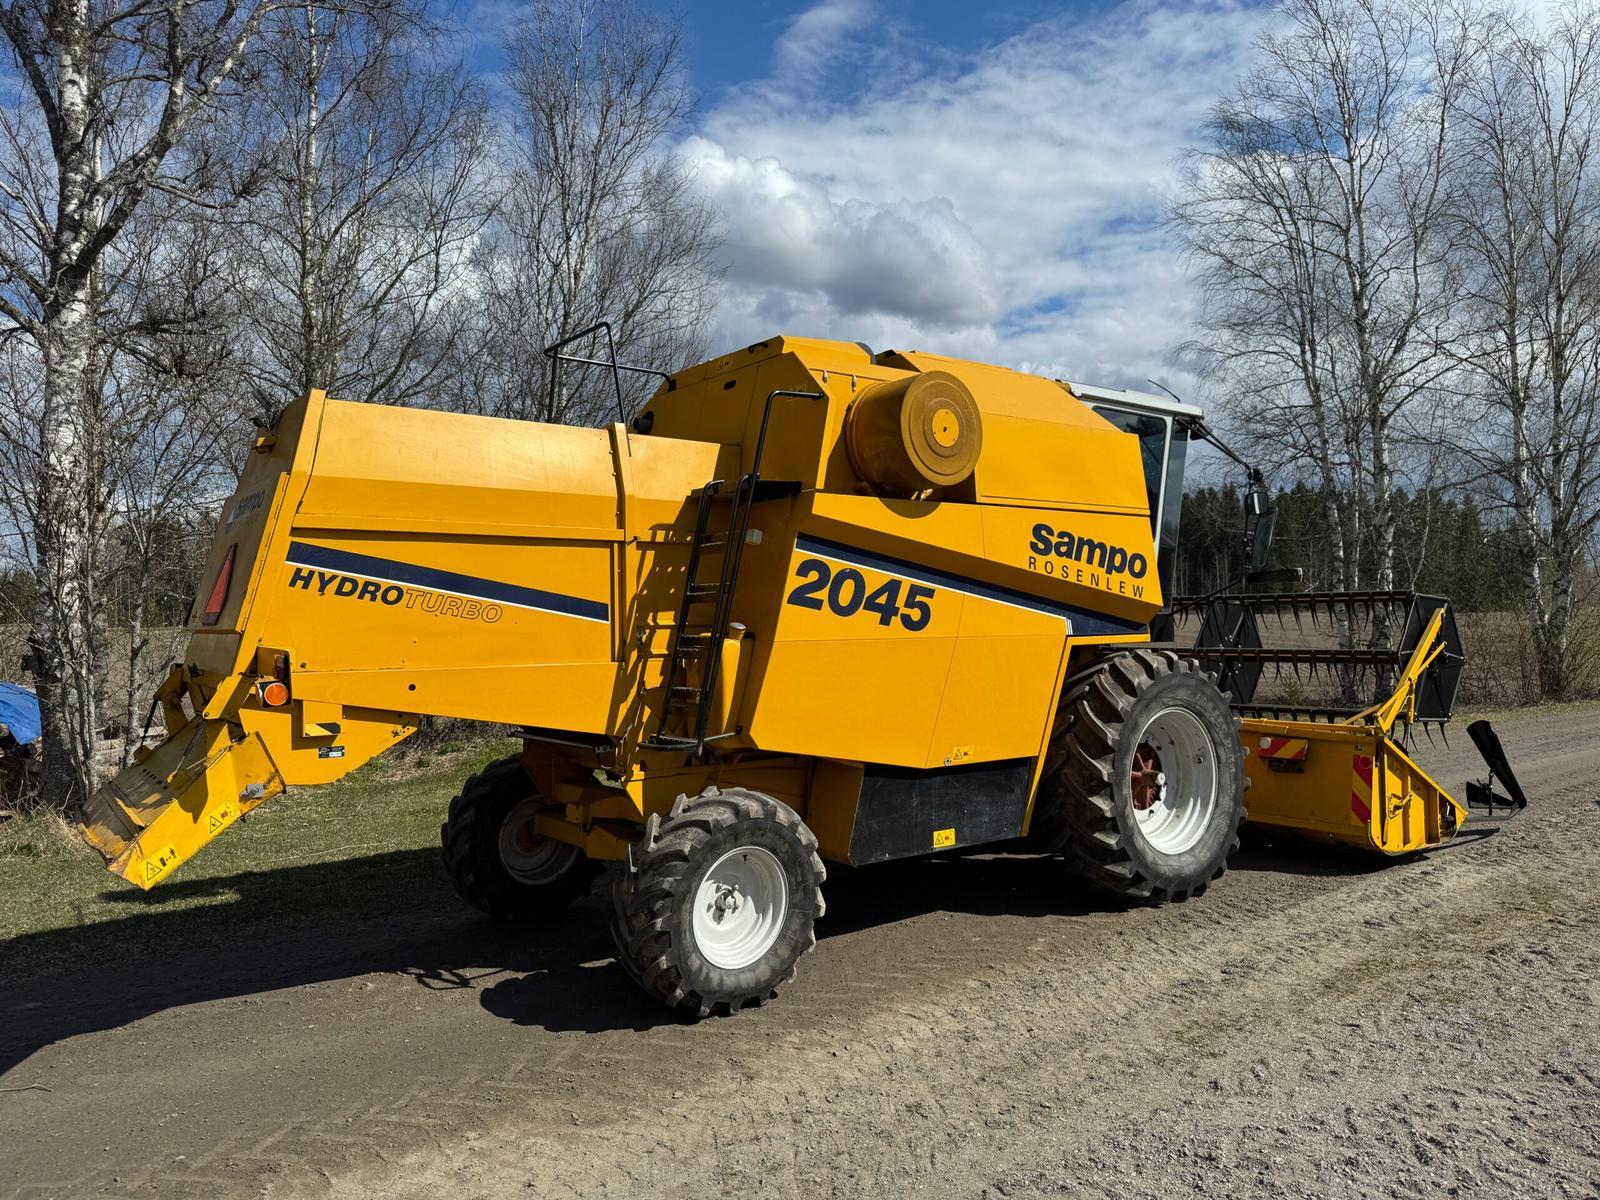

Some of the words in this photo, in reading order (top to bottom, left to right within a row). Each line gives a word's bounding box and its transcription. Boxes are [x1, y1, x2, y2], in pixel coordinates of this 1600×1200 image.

[1028, 556, 1144, 598] ROSENLEW
[1029, 523, 1148, 579] Sampo
[288, 568, 504, 623] HYDROTURBO
[786, 558, 936, 632] 2045
